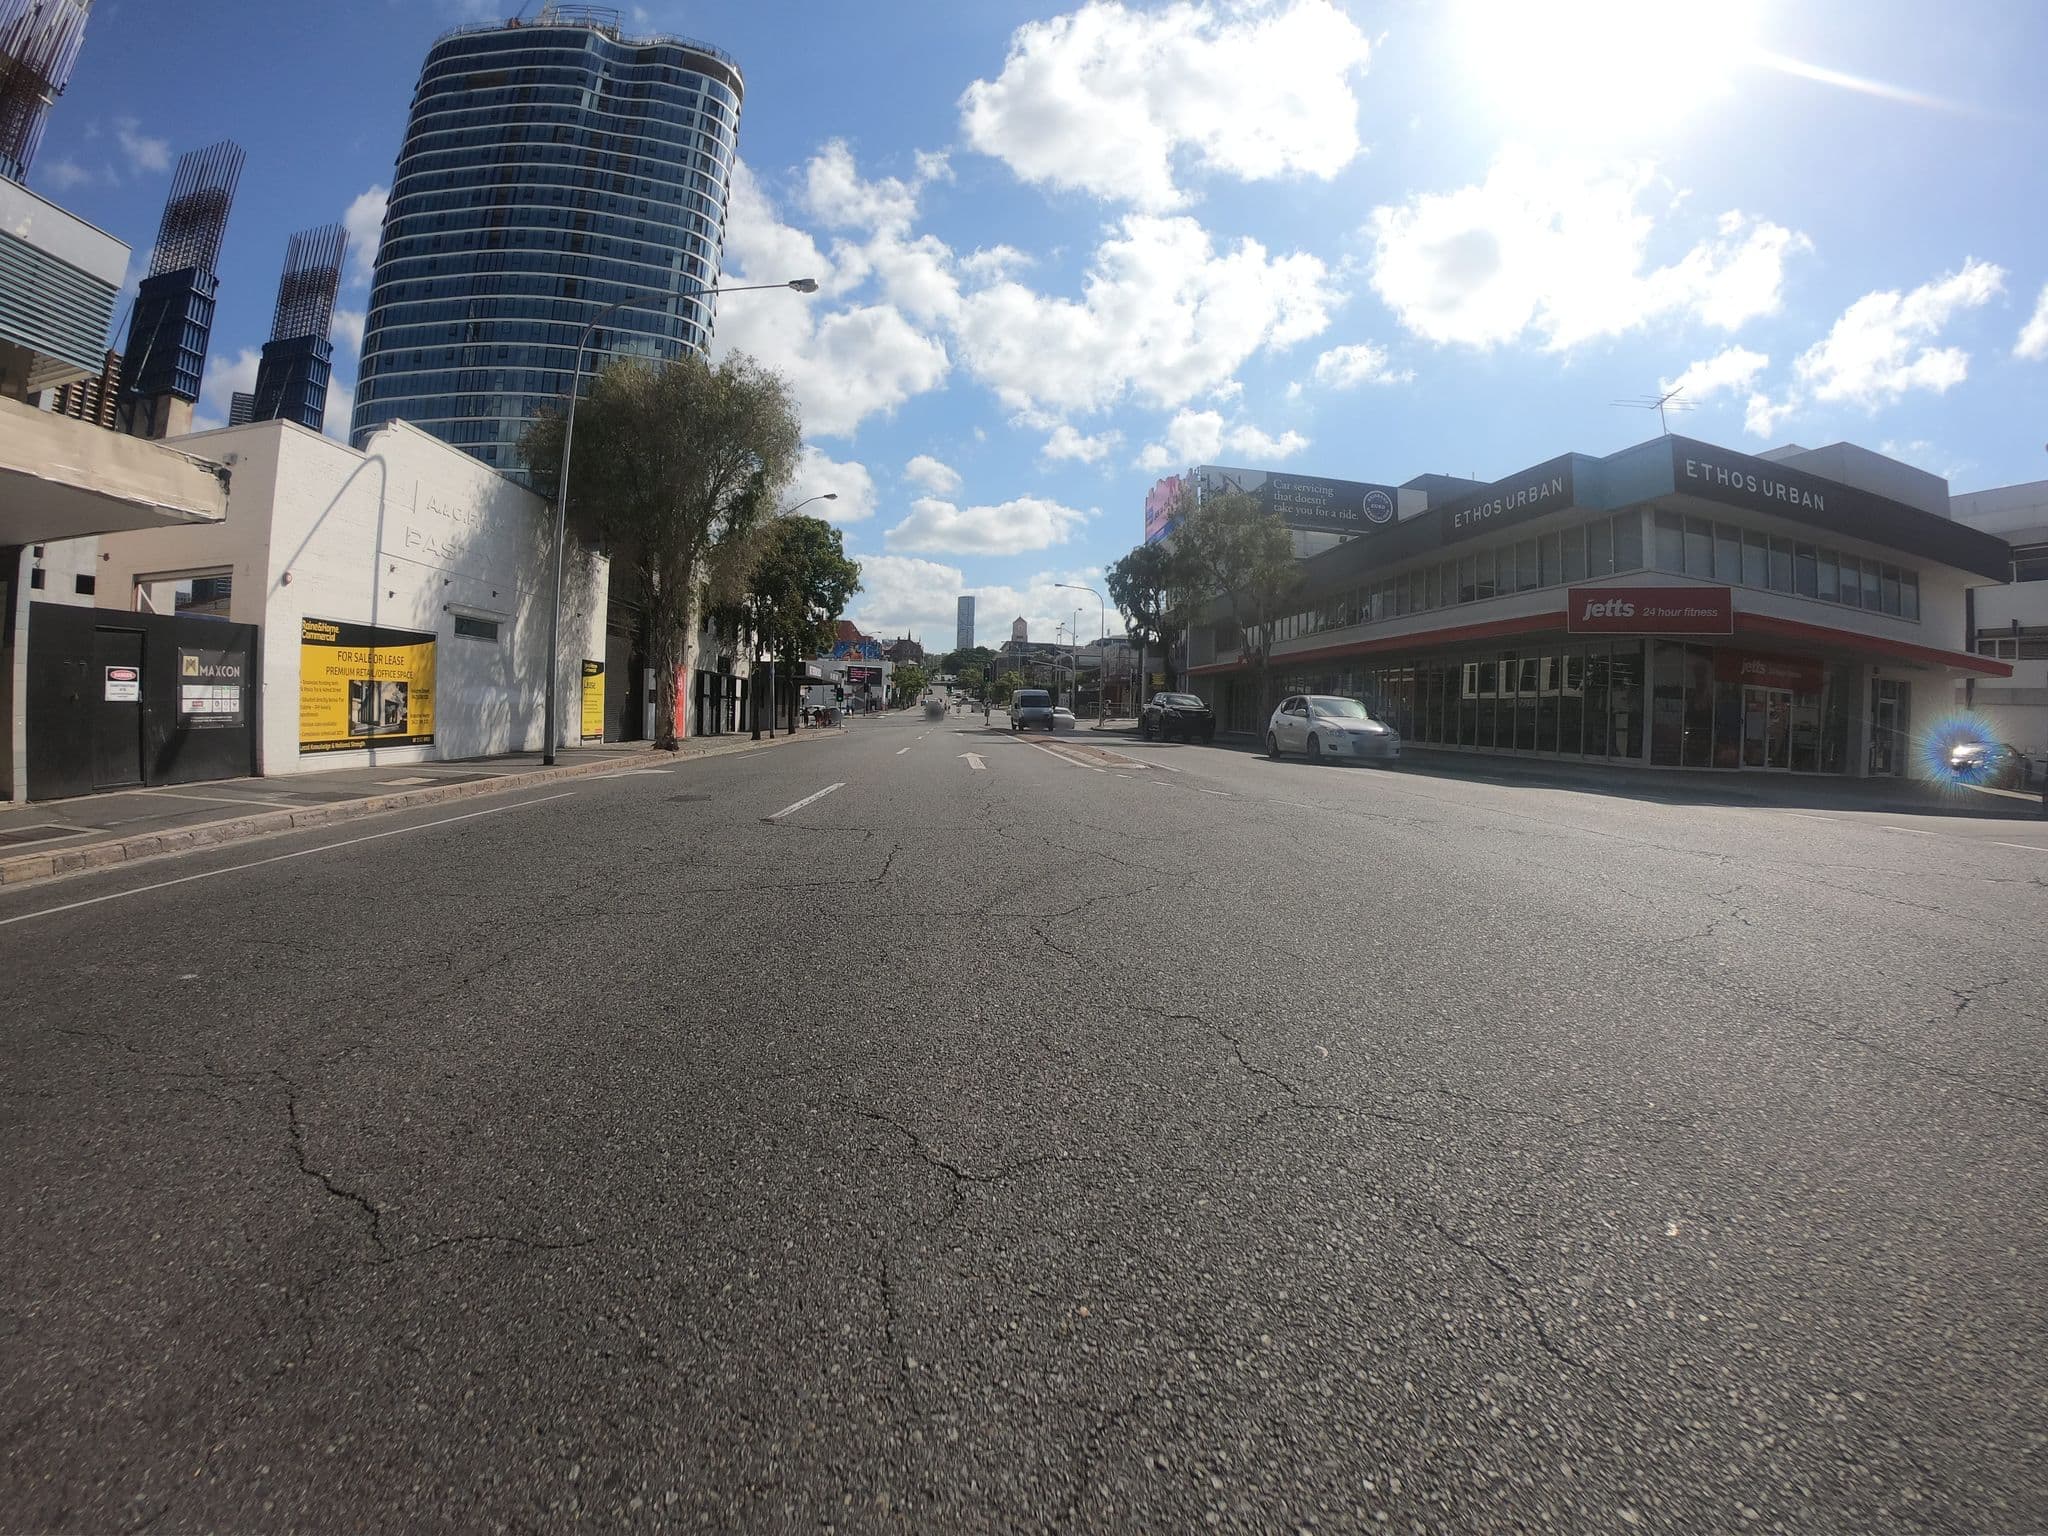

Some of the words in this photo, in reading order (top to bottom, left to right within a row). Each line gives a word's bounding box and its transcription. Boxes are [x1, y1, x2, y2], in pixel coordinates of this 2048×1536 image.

[1273, 479, 1290, 490] Car
[1294, 482, 1335, 497] servicing
[1685, 457, 1757, 493] ETHOS
[1762, 479, 1825, 512] URBAN
[1274, 490, 1293, 502] that
[1295, 493, 1327, 505] doesn't
[1454, 499, 1502, 528] ETHOS
[1505, 476, 1563, 510] URBAN
[1273, 502, 1293, 513] take
[1295, 505, 1313, 517] you
[1315, 506, 1330, 517] for
[1339, 509, 1359, 520] ride.
[1582, 598, 1636, 621] jetts
[1642, 607, 1655, 617] 24
[1658, 607, 1683, 617] hour
[1683, 607, 1719, 617] fitness
[337, 650, 353, 662] FOR
[354, 652, 372, 664] SALE
[373, 654, 383, 664] OR
[384, 654, 405, 666] LEASE
[1740, 657, 1767, 675] jetts
[199, 665, 241, 677] MAXCON
[325, 666, 355, 676] PREMIUM
[397, 669, 414, 679] SPACE
